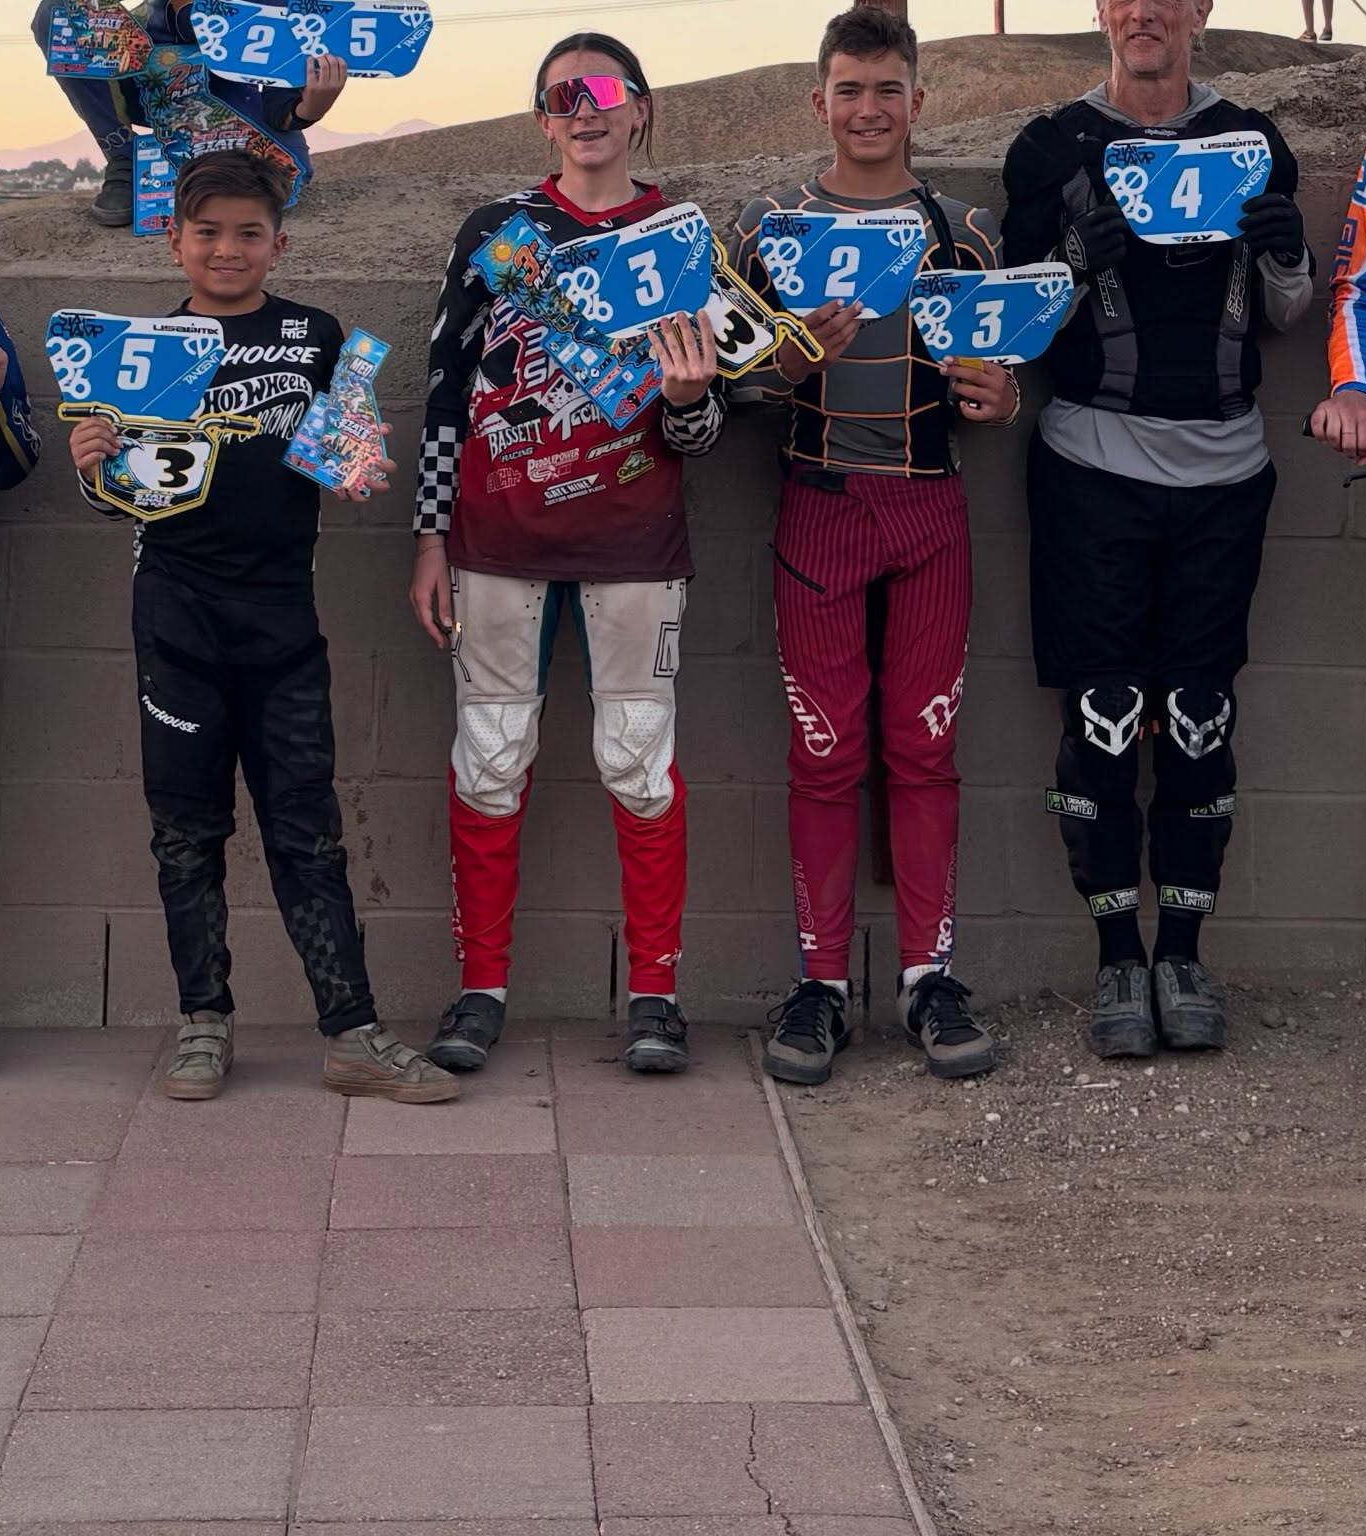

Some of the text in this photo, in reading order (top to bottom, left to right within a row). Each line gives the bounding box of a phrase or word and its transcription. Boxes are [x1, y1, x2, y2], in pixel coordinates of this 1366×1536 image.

[190, 12, 230, 40] 20
[288, 13, 327, 40] 20
[350, 17, 378, 57] 5
[197, 35, 227, 61] 26
[241, 24, 276, 64] 2
[299, 34, 329, 58] 26
[1105, 150, 1156, 167] CHAMP
[1104, 165, 1149, 196] 20
[1170, 167, 1203, 219] 4
[1237, 162, 1270, 197] TANGENT
[1115, 193, 1154, 224] 26
[761, 222, 811, 238] CHAMP
[1171, 234, 1214, 243] FLY
[686, 231, 711, 271] TANGENT
[757, 236, 803, 268] 20
[888, 240, 924, 276] TANGENT
[557, 265, 601, 300] 20
[628, 249, 666, 307] 3
[766, 265, 805, 297] 26
[824, 245, 861, 298] 2
[912, 281, 961, 297] CHAMP
[576, 292, 614, 323] 26
[909, 295, 953, 323] 20
[1036, 290, 1070, 324] TANGENT
[50, 322, 105, 339] CHAMP
[713, 309, 756, 355] 3
[918, 322, 954, 351] 26
[971, 299, 1005, 349] 3
[46, 336, 92, 369] 20
[117, 337, 156, 391] 5
[182, 351, 221, 385] TANGENT
[53, 364, 92, 400] 26
[487, 417, 546, 464] BASSETT
[501, 446, 535, 463] RACING
[155, 447, 196, 488] 3
[1067, 804, 1094, 815] UNITED
[1184, 897, 1211, 908] UNITED
